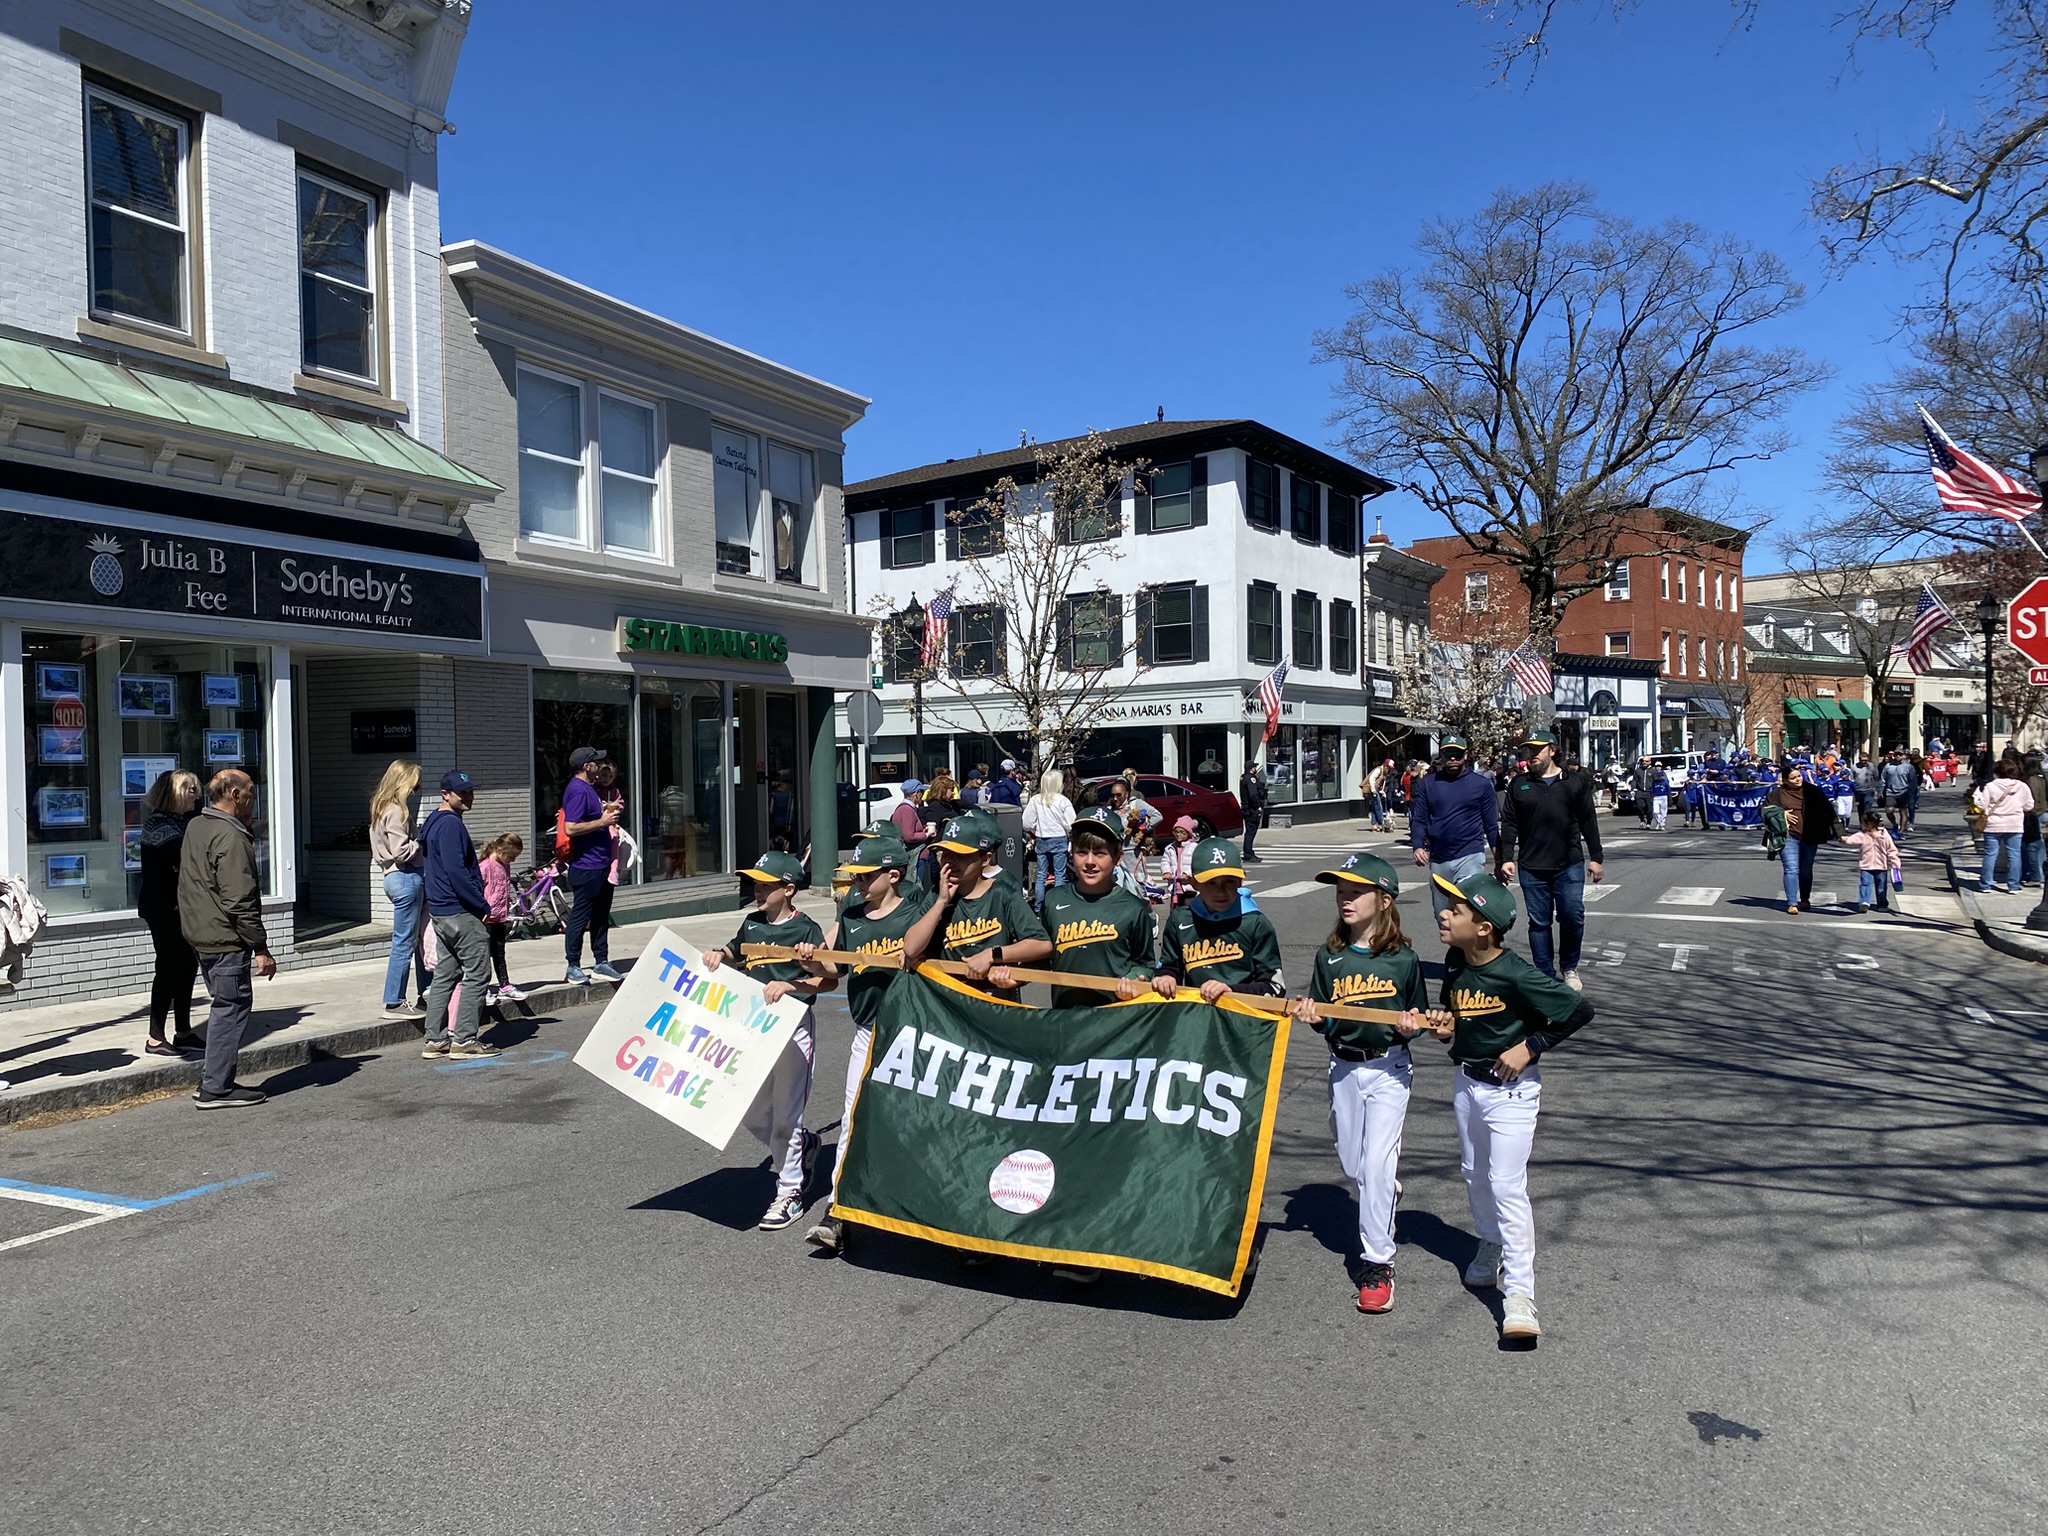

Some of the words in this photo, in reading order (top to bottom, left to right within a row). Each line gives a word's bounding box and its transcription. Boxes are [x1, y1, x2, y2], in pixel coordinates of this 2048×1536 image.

[715, 455, 734, 469] Custom
[140, 538, 199, 571] Julia
[207, 547, 227, 574] B
[184, 581, 228, 611] Fee
[280, 557, 413, 612] Sotheby's
[281, 604, 373, 624] INTERNATIONAL
[375, 613, 413, 627] REALTY
[625, 618, 789, 664] STARBUCKS
[1131, 704, 1172, 717] MARIA'S
[1181, 702, 1204, 716] BAR
[1707, 794, 1737, 808] BLUE
[1056, 919, 1118, 944] Athletics
[1182, 938, 1243, 964] Athletics
[658, 947, 739, 1018] THANK
[743, 994, 780, 1034] YOU
[1331, 973, 1397, 1002] Athletics
[644, 1001, 744, 1076] ANTIQUE
[615, 1035, 714, 1110] GARAGE
[870, 1024, 1248, 1138] ATHLETICS
